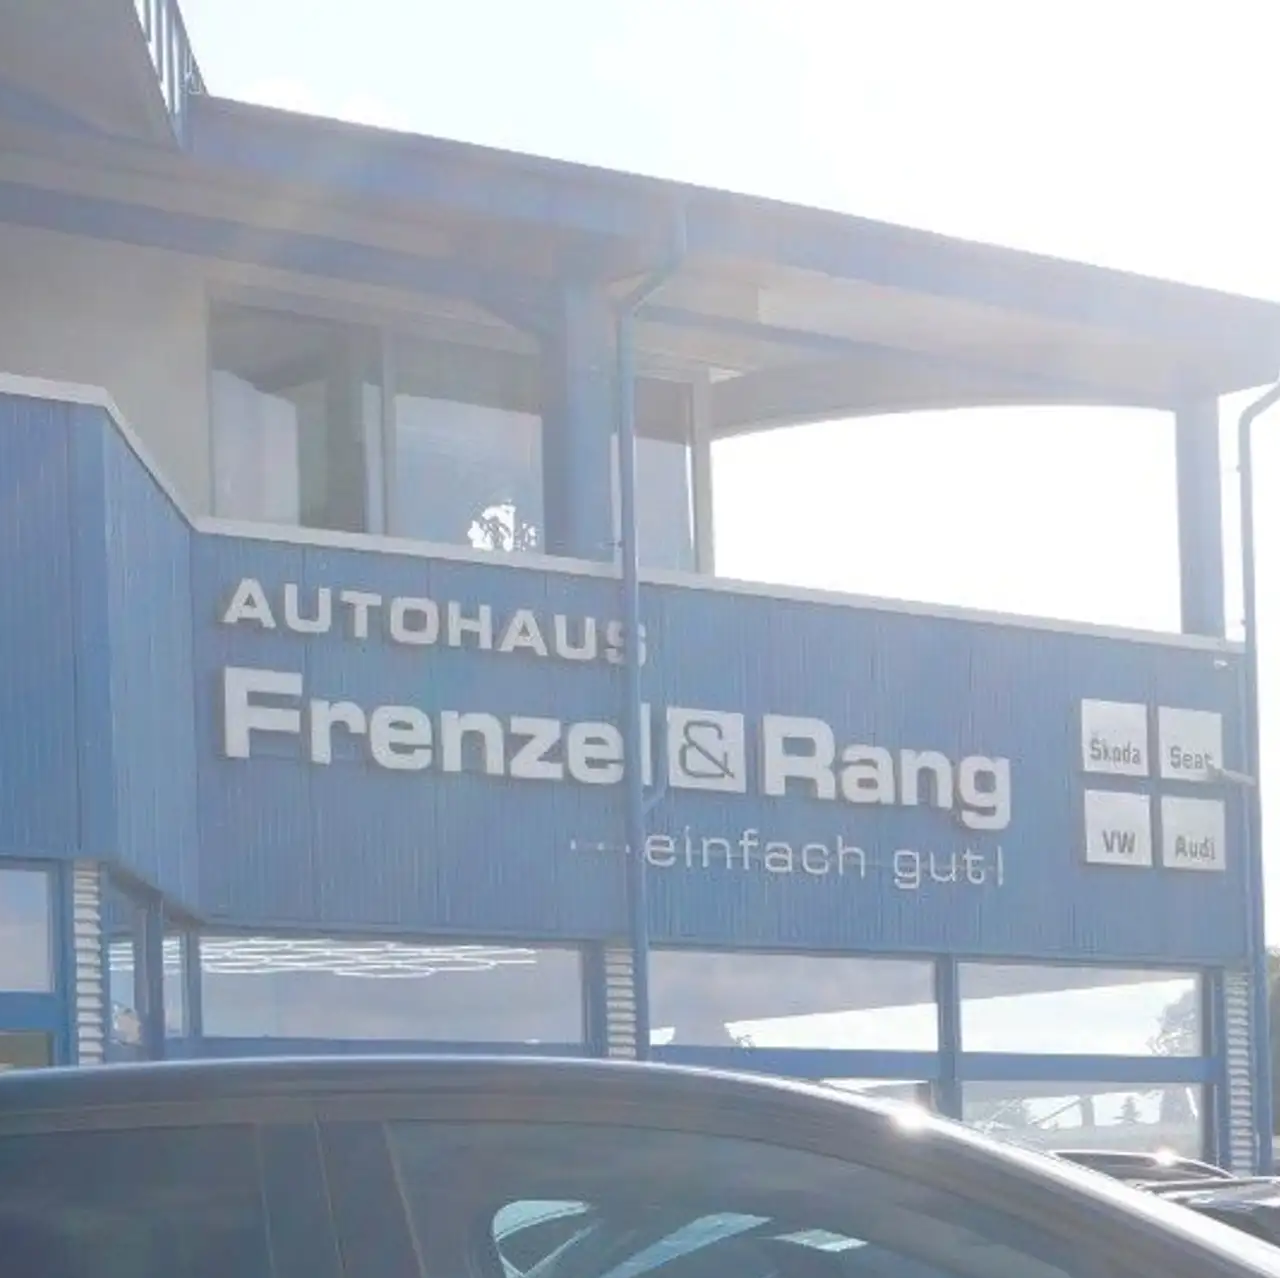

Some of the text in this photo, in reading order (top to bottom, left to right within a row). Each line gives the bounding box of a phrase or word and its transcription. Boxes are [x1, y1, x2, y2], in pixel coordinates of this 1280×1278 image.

[222, 578, 647, 667] AUTOHAUS
[223, 666, 1011, 830] Frenzel & Rang
[1170, 746, 1213, 770] Seat
[1102, 830, 1136, 854] VW
[1175, 835, 1217, 861] Audi
